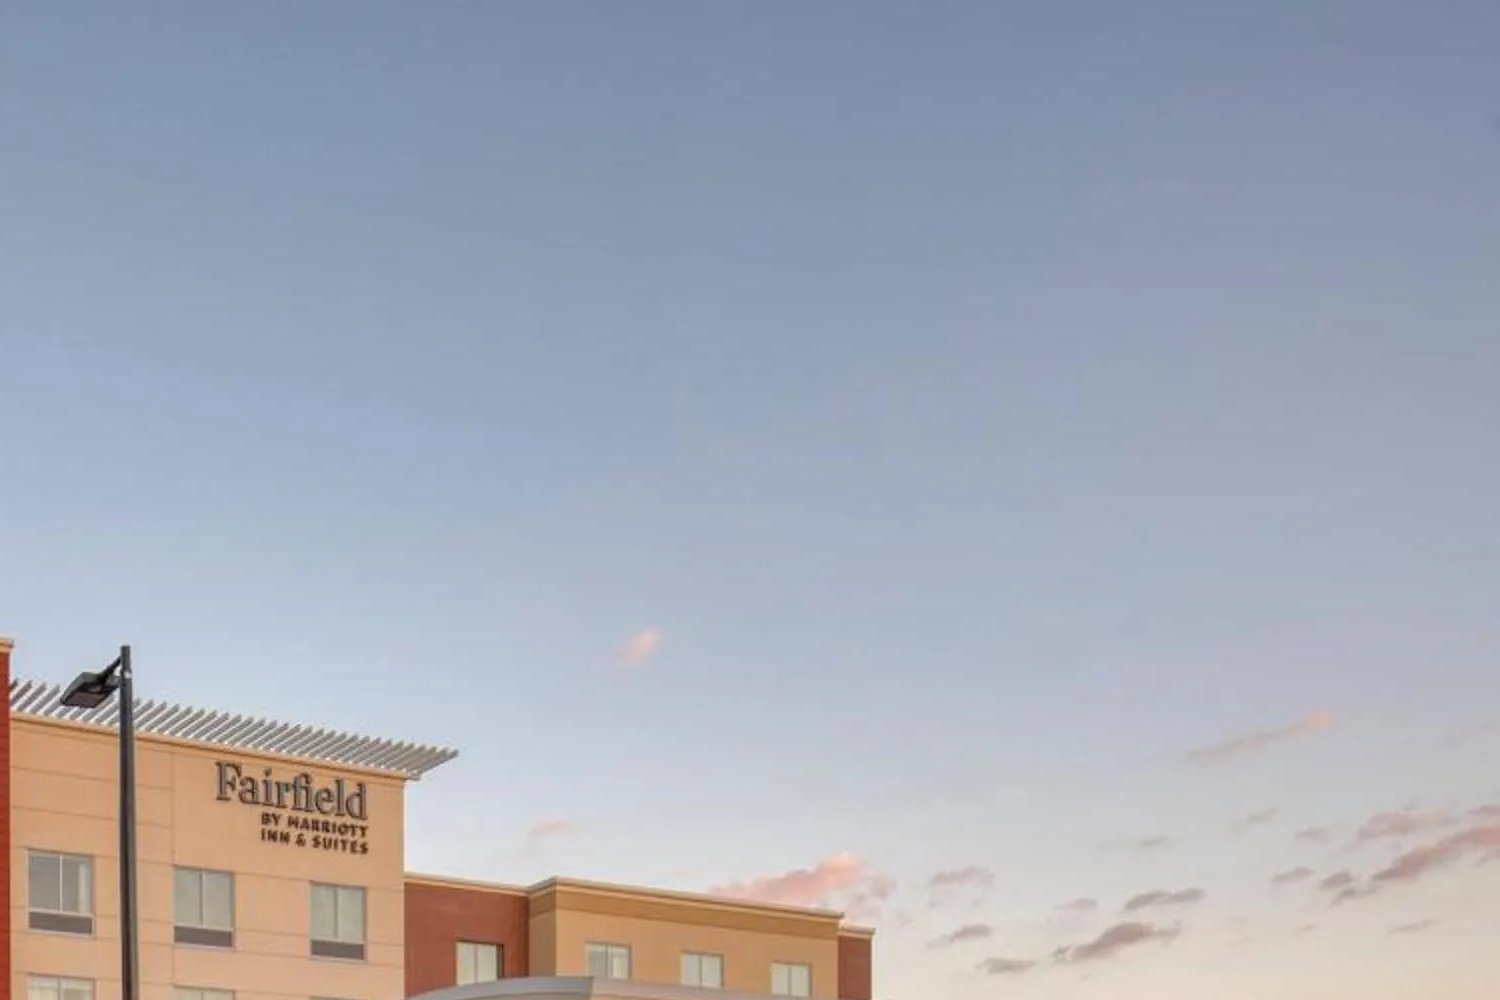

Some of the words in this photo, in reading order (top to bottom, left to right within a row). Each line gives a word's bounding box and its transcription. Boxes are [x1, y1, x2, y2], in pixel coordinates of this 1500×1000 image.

[215, 760, 369, 820] Fairfield
[261, 812, 281, 825] BY
[287, 816, 369, 838] MARRIOTT
[261, 829, 290, 844] INN
[295, 833, 307, 847] &
[312, 835, 368, 854] SUITES
